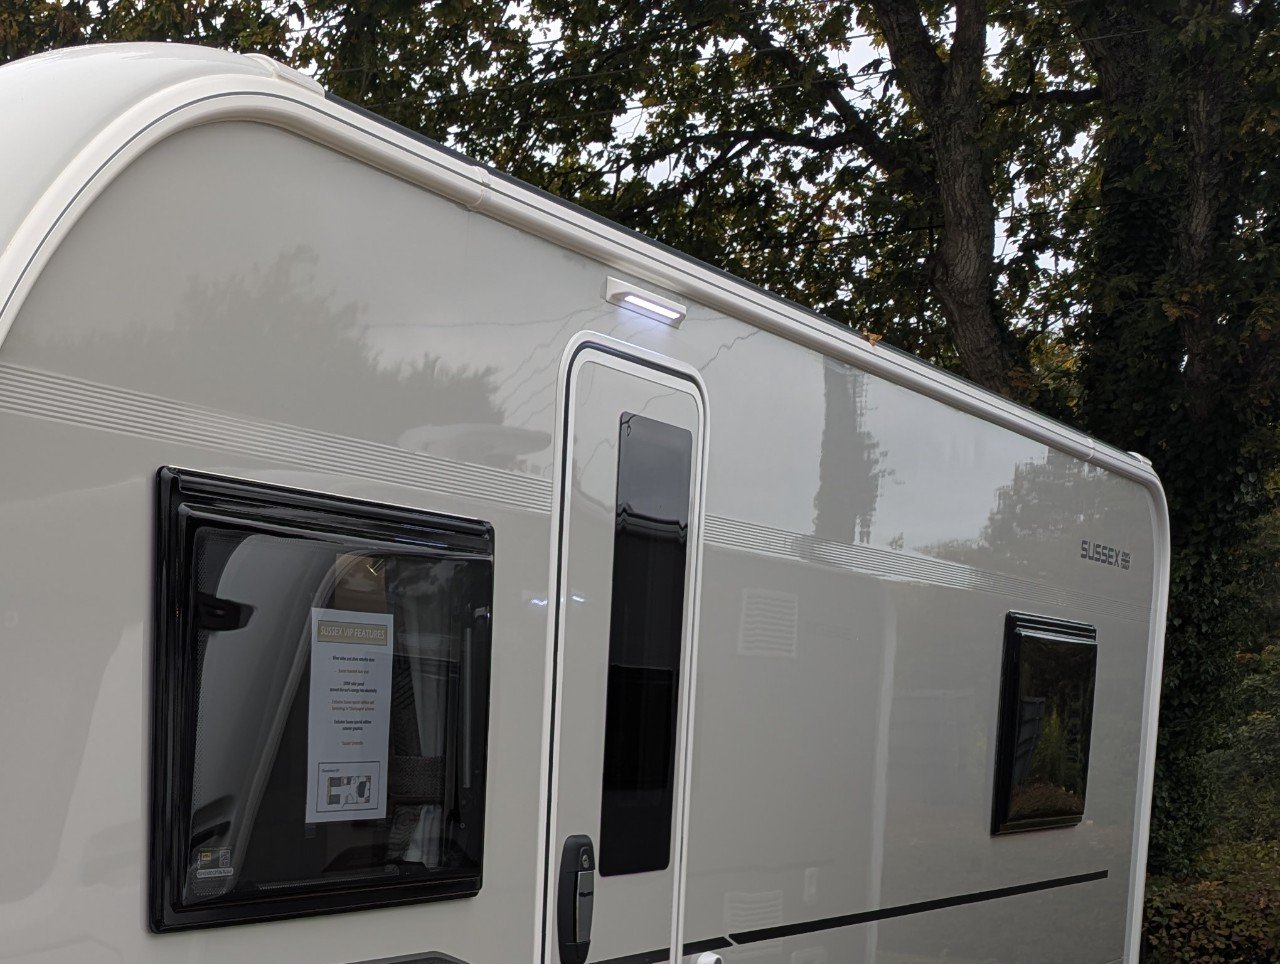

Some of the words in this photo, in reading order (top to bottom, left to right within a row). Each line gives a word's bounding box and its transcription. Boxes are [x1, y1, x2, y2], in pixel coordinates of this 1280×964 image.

[1081, 540, 1120, 567] SUSSEX
[320, 625, 343, 636] SUSSEX
[343, 627, 354, 637] VIP
[354, 628, 385, 639] FEATURES
